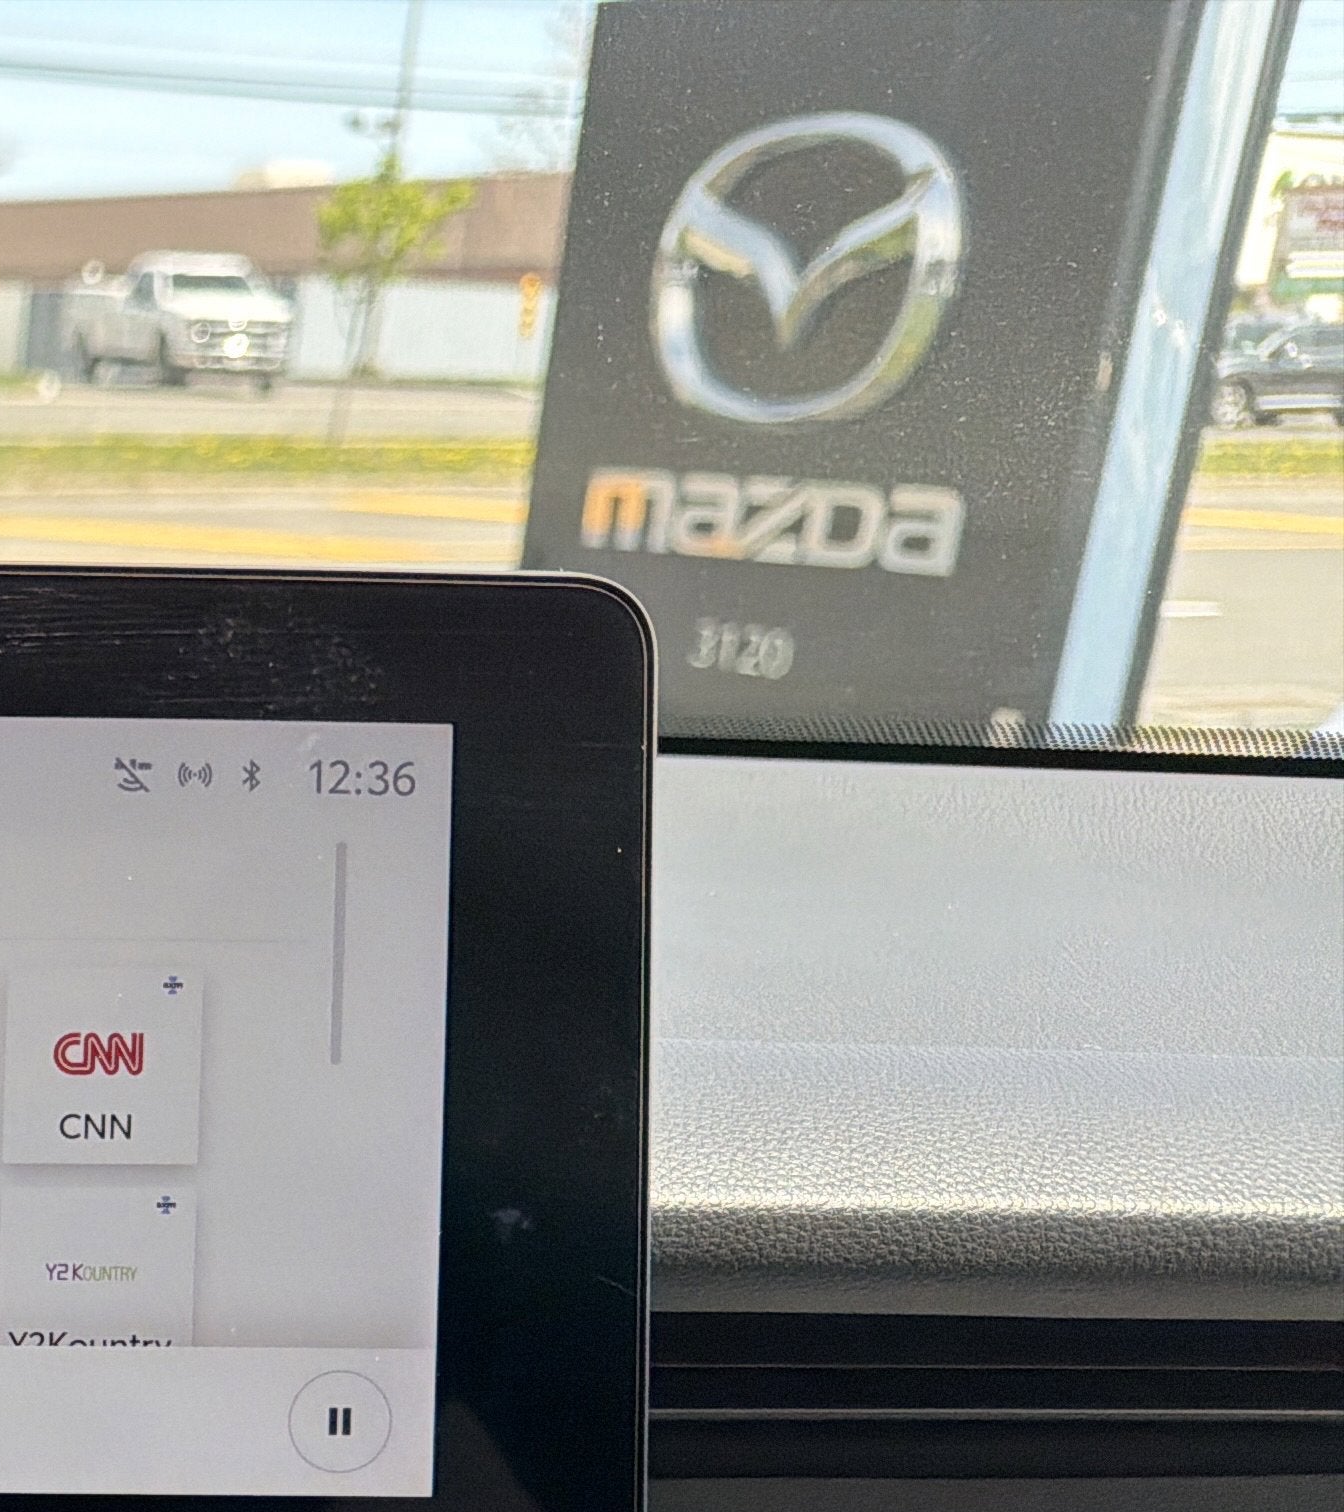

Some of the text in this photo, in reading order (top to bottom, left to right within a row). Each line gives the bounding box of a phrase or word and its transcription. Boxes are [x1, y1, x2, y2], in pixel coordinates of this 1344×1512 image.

[310, 760, 416, 796] 12:36
[53, 1032, 145, 1076] CNN
[59, 1113, 133, 1140] CNN
